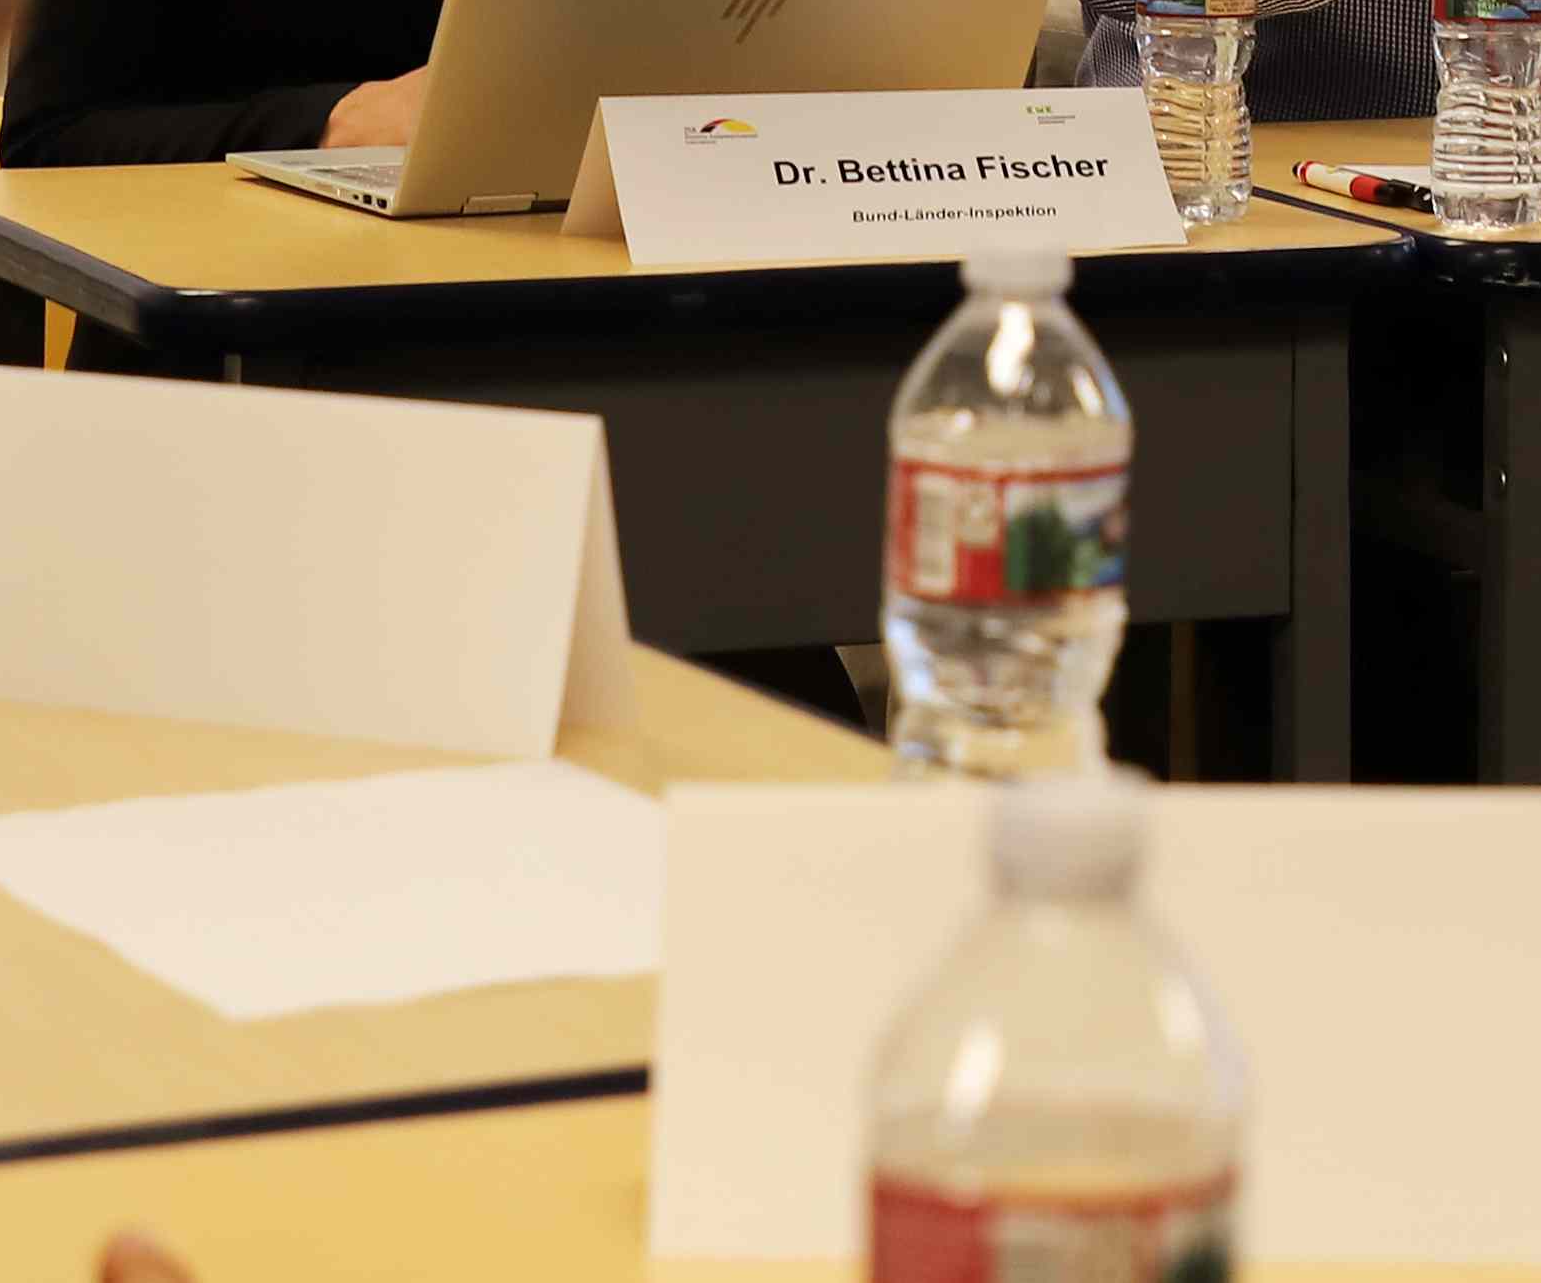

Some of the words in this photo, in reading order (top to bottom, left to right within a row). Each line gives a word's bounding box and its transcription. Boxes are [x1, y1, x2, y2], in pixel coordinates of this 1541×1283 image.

[773, 160, 827, 185] Dr.
[837, 157, 967, 184] Bettina
[975, 154, 1109, 180] Fischer
[852, 205, 1058, 223] Bund-Länder-Inspektion
